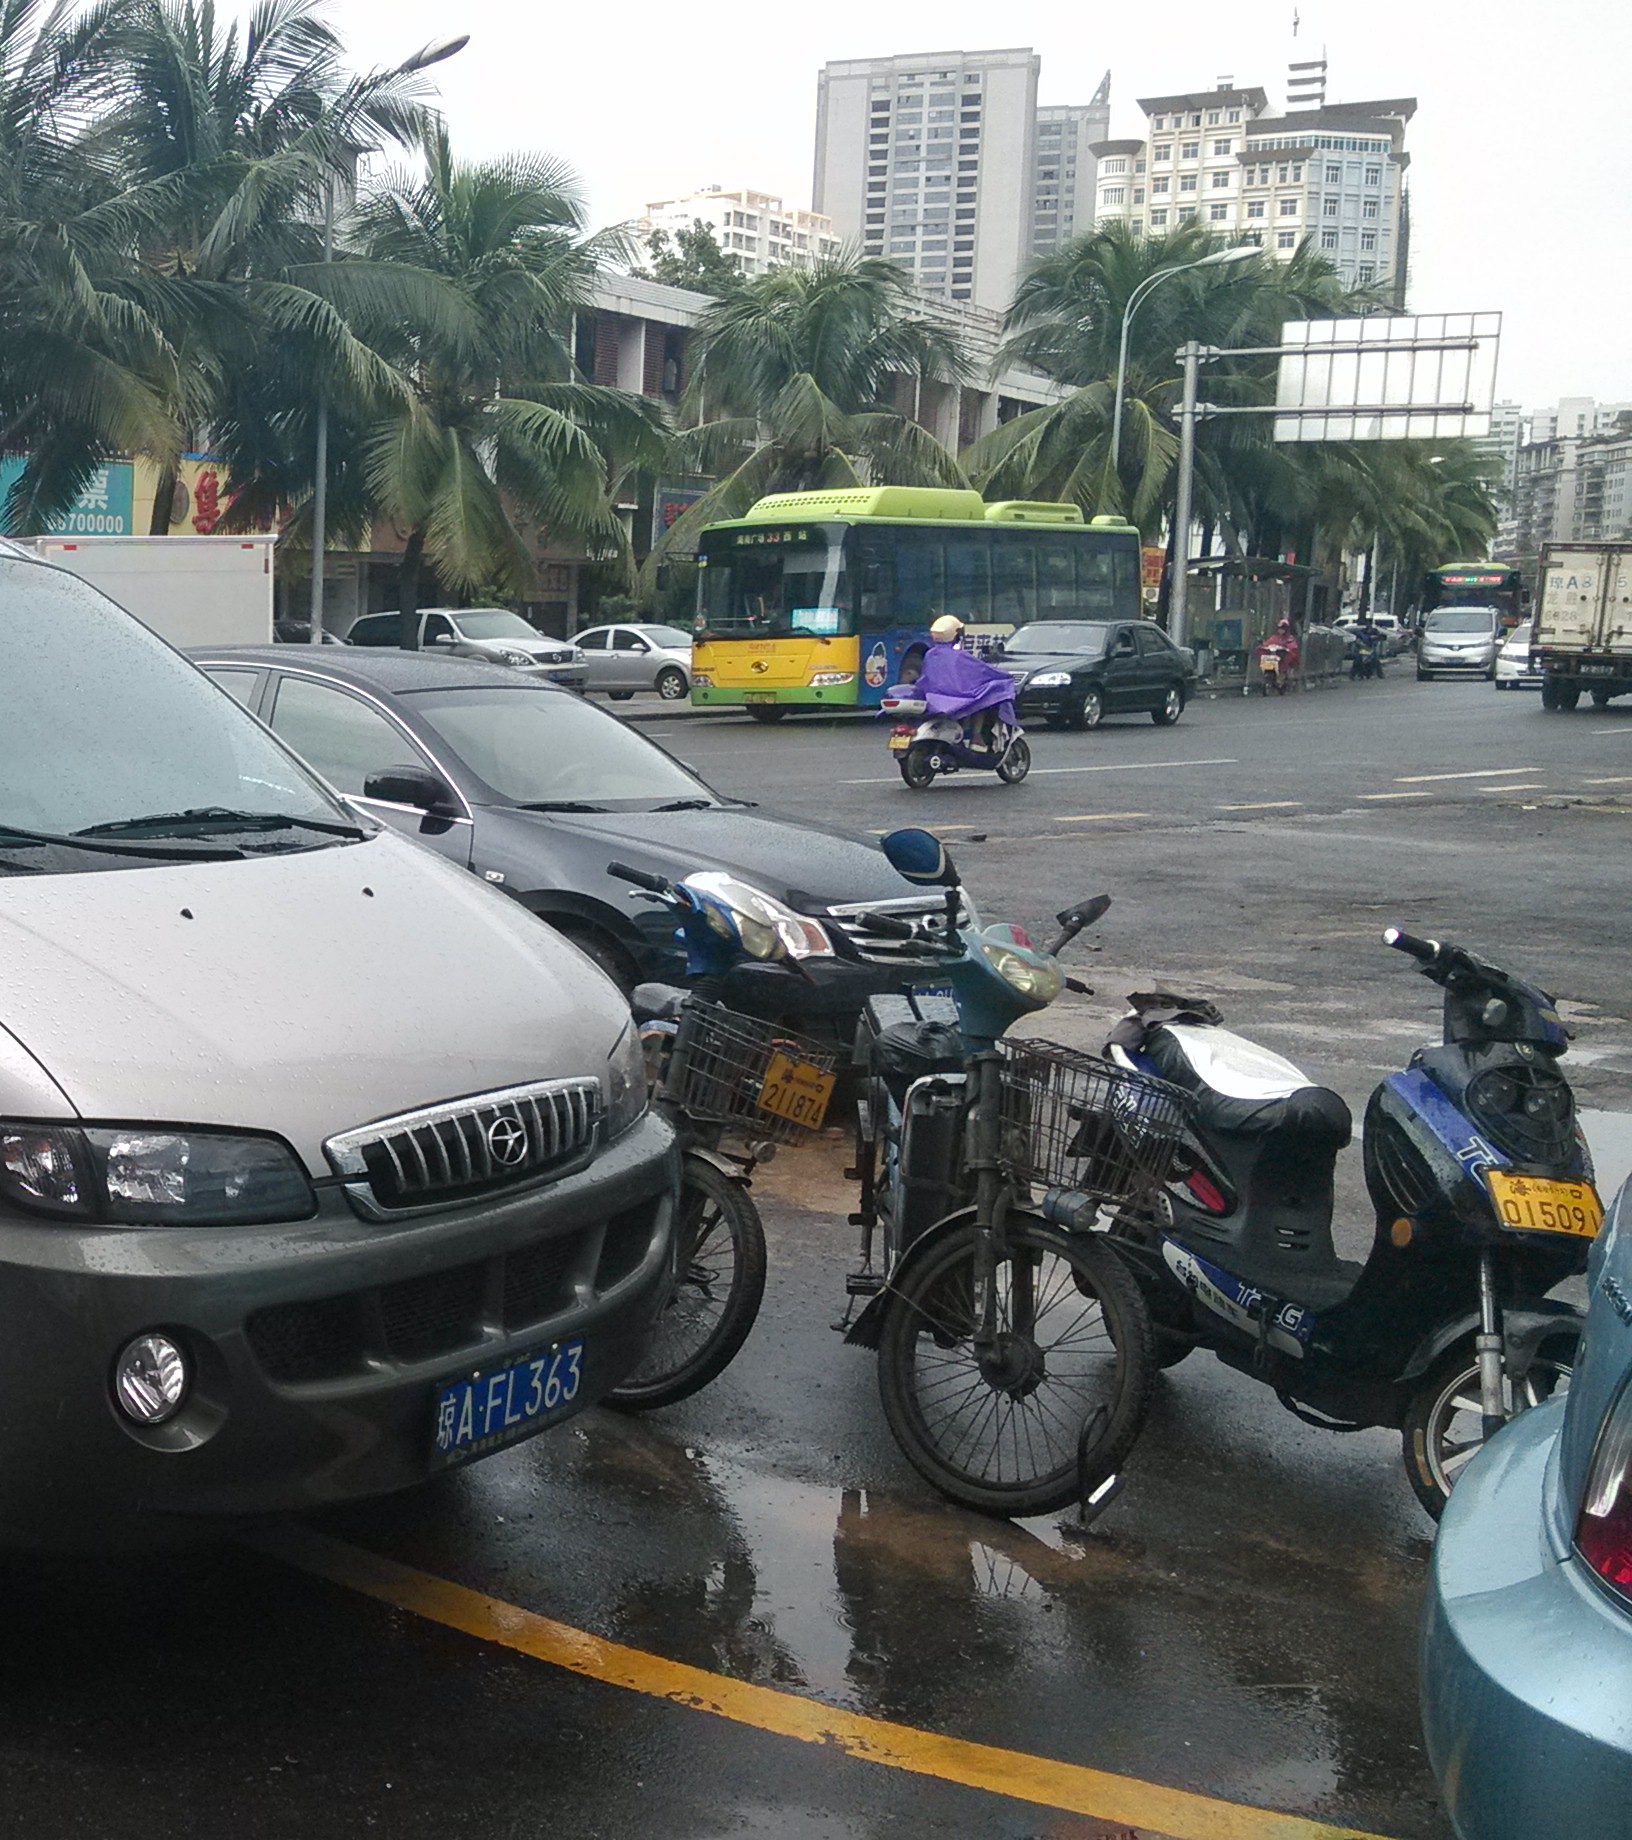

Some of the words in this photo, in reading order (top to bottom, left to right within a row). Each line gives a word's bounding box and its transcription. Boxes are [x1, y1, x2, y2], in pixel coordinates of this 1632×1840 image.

[766, 531, 780, 543] 33
[763, 1083, 824, 1123] 211874
[1503, 1199, 1599, 1233] 015091
[436, 1345, 583, 1449] 琼A·FL363
